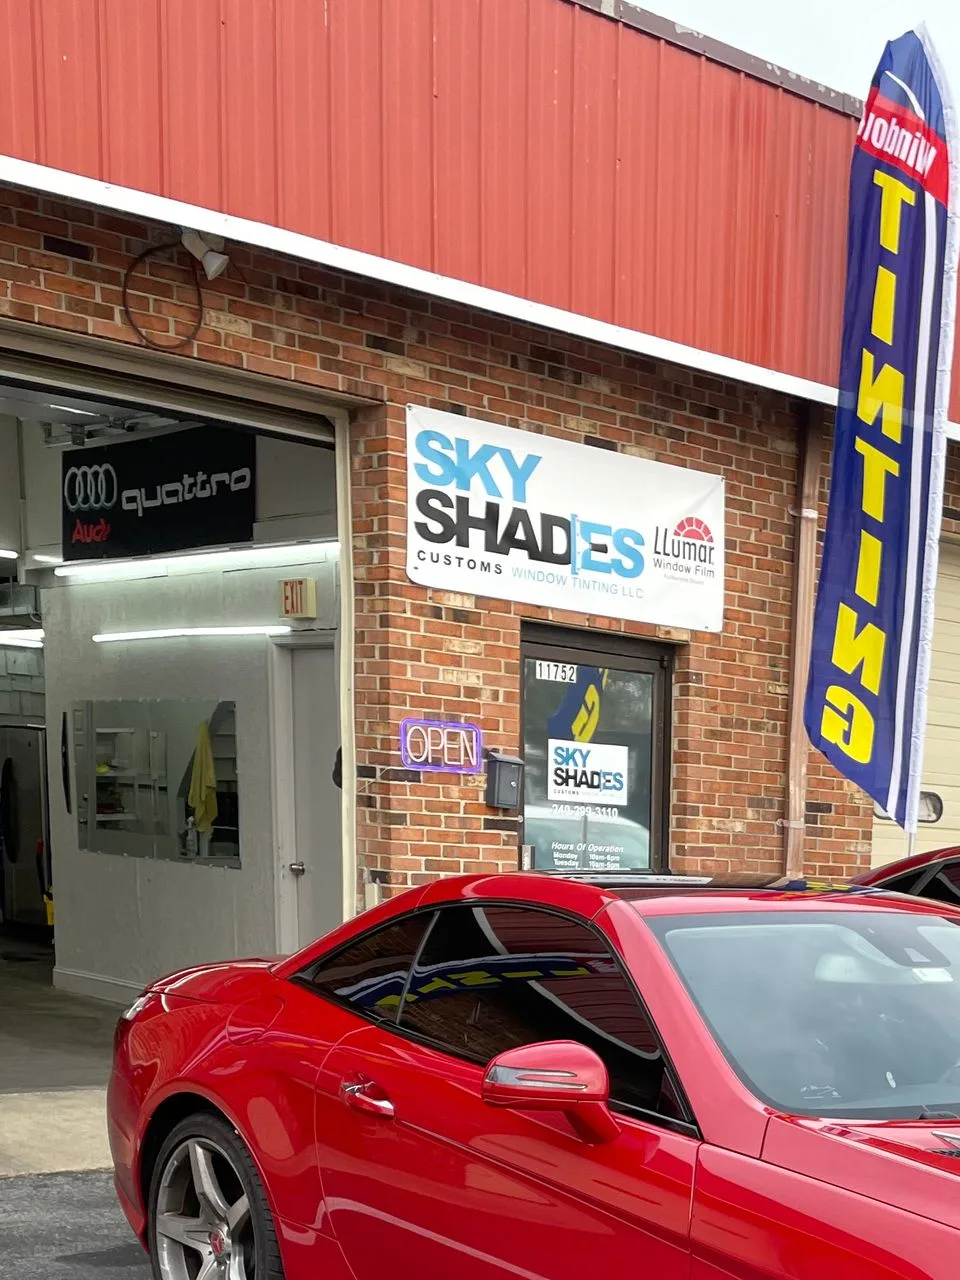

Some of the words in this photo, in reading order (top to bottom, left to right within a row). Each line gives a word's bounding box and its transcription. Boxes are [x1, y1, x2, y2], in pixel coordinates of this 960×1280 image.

[414, 430, 542, 503] SKY
[121, 467, 251, 516] quattro
[414, 488, 646, 579] SHADES
[653, 526, 715, 564] LLumar
[417, 550, 503, 575] CUSTOMS
[511, 567, 568, 586] WINDOW
[572, 576, 618, 595] TINTING
[622, 585, 645, 600] LLC
[653, 558, 691, 574] Window
[695, 565, 715, 579] Film
[283, 580, 304, 615] EXIT
[538, 662, 576, 682] 11752
[406, 726, 477, 766] OPEN
[553, 746, 591, 768] SKY
[553, 767, 624, 792] SHADES
[551, 842, 574, 851] Hours
[576, 843, 586, 851] Of
[587, 843, 625, 853] Operation
[553, 851, 579, 861] Monday
[553, 859, 580, 869] Tuesday
